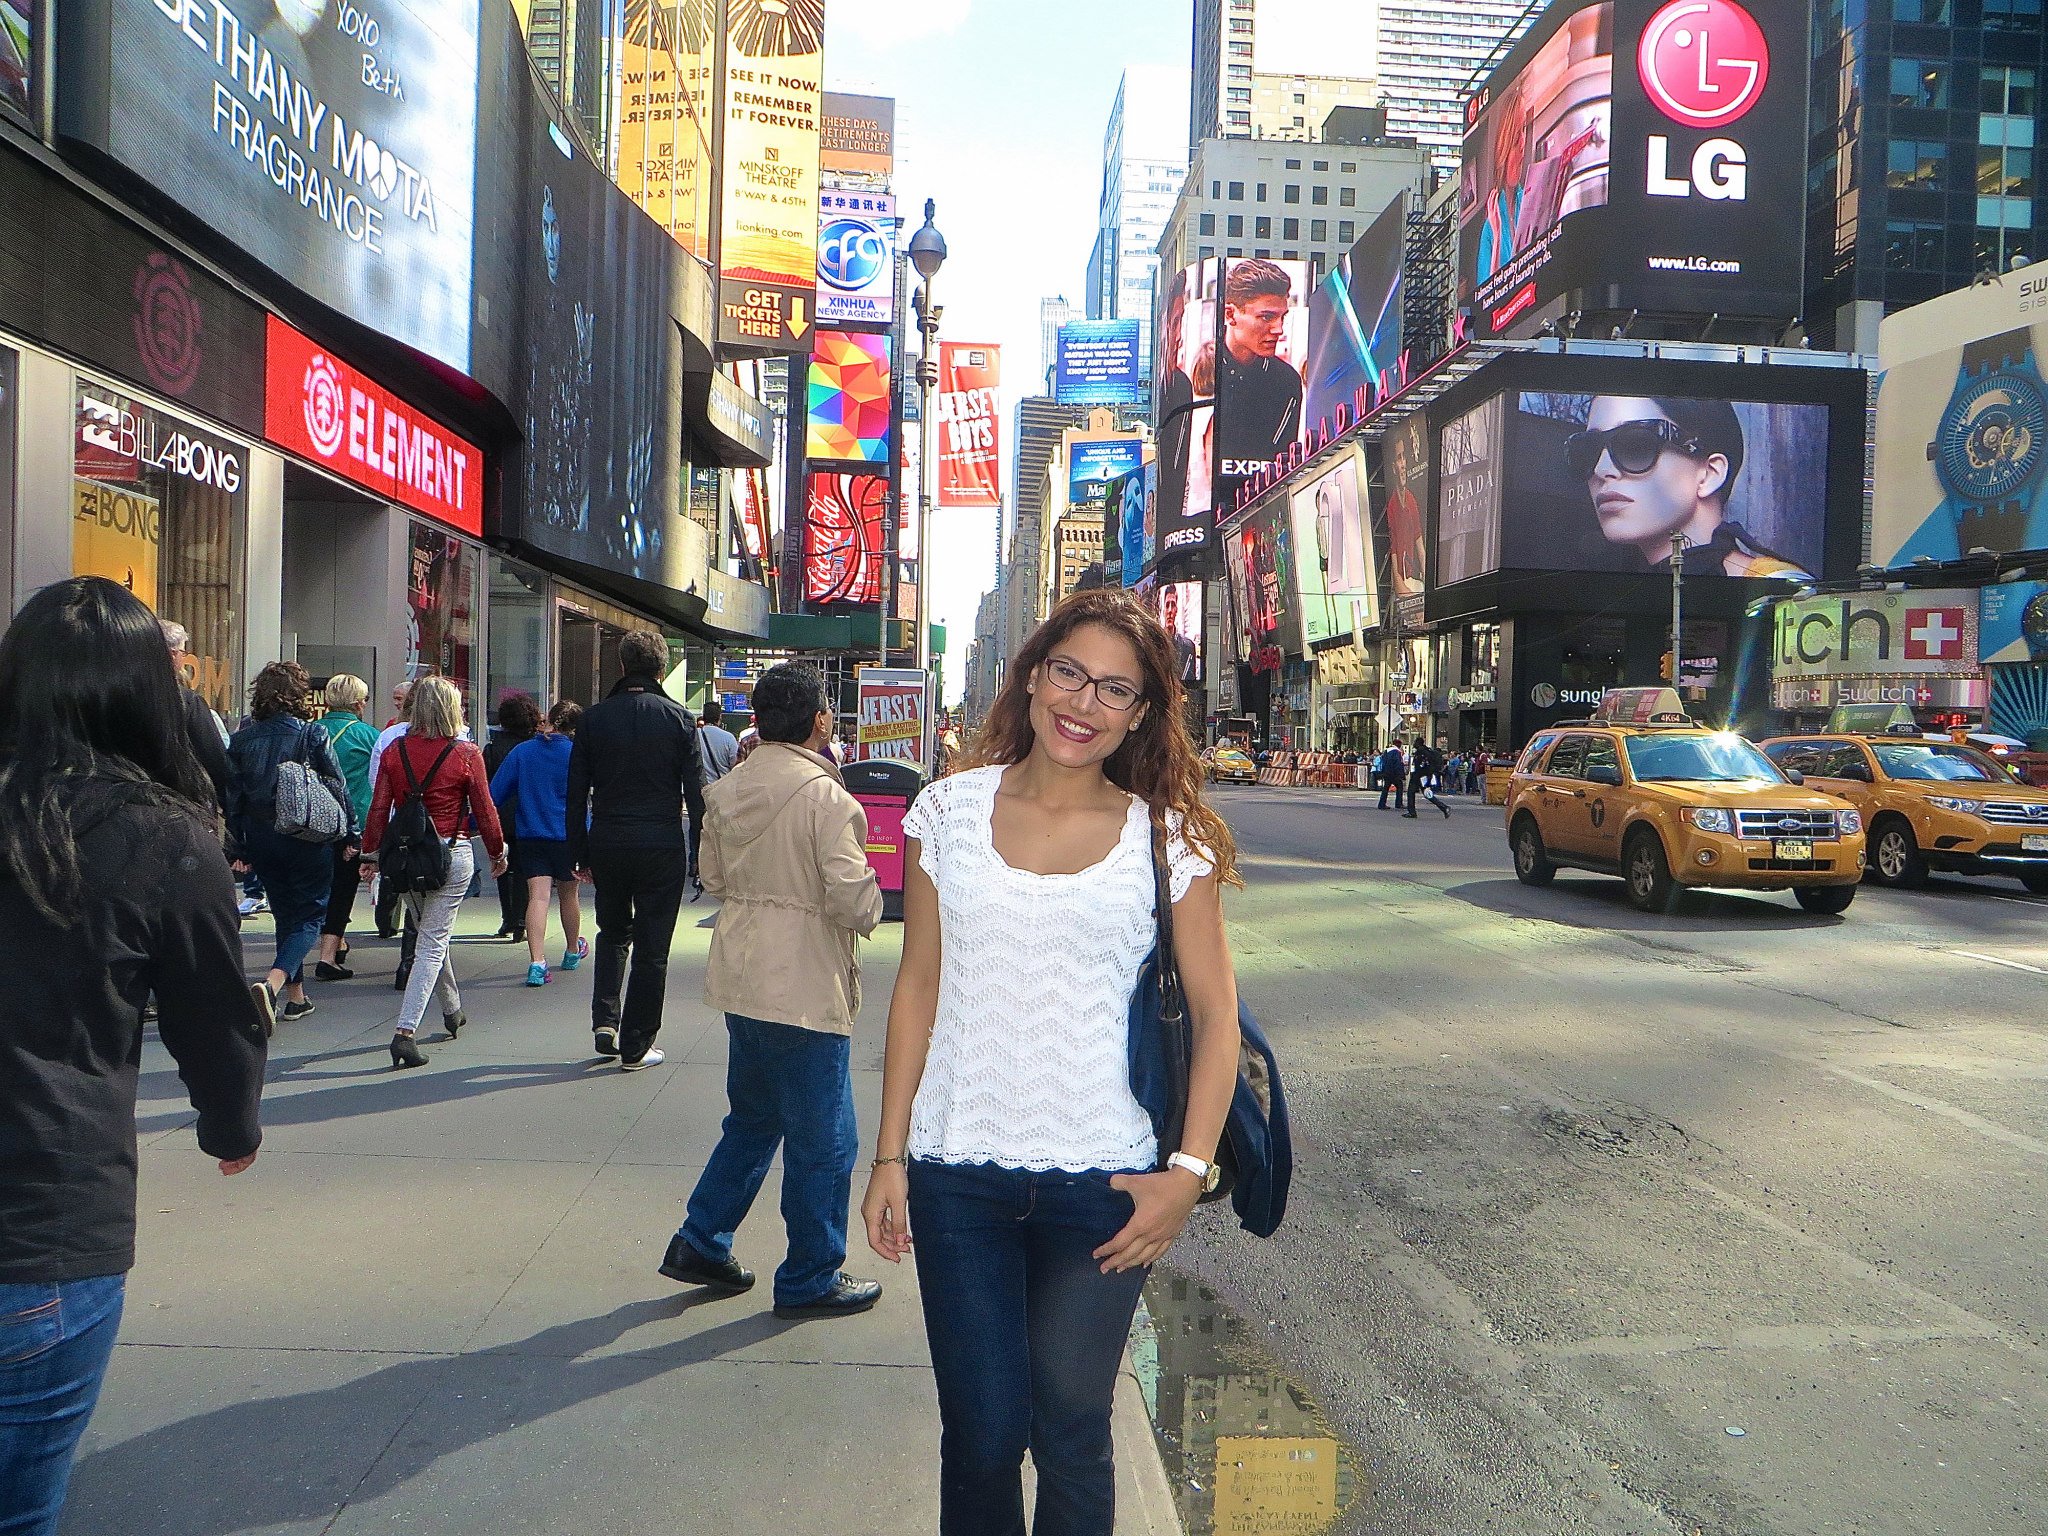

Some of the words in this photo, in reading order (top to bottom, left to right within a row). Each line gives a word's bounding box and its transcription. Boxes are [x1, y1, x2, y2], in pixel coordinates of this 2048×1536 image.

[154, 0, 326, 152] ETHANY
[361, 54, 405, 102] Beth
[731, 68, 754, 82] SEE
[760, 73, 773, 84] IT
[778, 76, 819, 93] NOW.
[734, 91, 812, 114] REMEMBER
[1478, 87, 1490, 112] LG
[731, 108, 744, 119] IT
[749, 110, 819, 132] FOREVER.
[821, 115, 851, 128] THESE
[853, 119, 879, 130] DAYS
[820, 127, 891, 143] RETIREMENTS
[820, 138, 845, 149] LAST
[848, 141, 888, 153] LONGER
[213, 81, 384, 255] FRAGRANCE
[738, 160, 804, 178] MINSKOFF
[1647, 135, 1747, 200] LG
[746, 171, 798, 190] THEATRE
[735, 188, 766, 201] B'WAY
[770, 194, 778, 203] &
[781, 196, 806, 206] 45TH
[821, 196, 888, 212] 新华通讯社
[736, 219, 803, 239] lionking.com
[1648, 256, 1741, 273] www.LG.com
[744, 289, 783, 309] GET
[829, 297, 876, 310] XINHUA
[724, 303, 782, 322] TICKETS
[818, 308, 846, 317] NEWS
[847, 310, 886, 319] AGENCY
[738, 319, 781, 338] HERE
[938, 386, 1000, 423] JERSEY
[948, 417, 994, 453] BOYS
[119, 410, 241, 494] BILLABONG
[350, 386, 467, 511] ELEMENT
[1447, 470, 1494, 508] PRADA
[1163, 526, 1205, 551] EXPRESS
[1838, 684, 1915, 702] swatch
[860, 693, 921, 726] JERSEY
[1660, 713, 1681, 723] 4K64
[869, 738, 916, 761] BOYS
